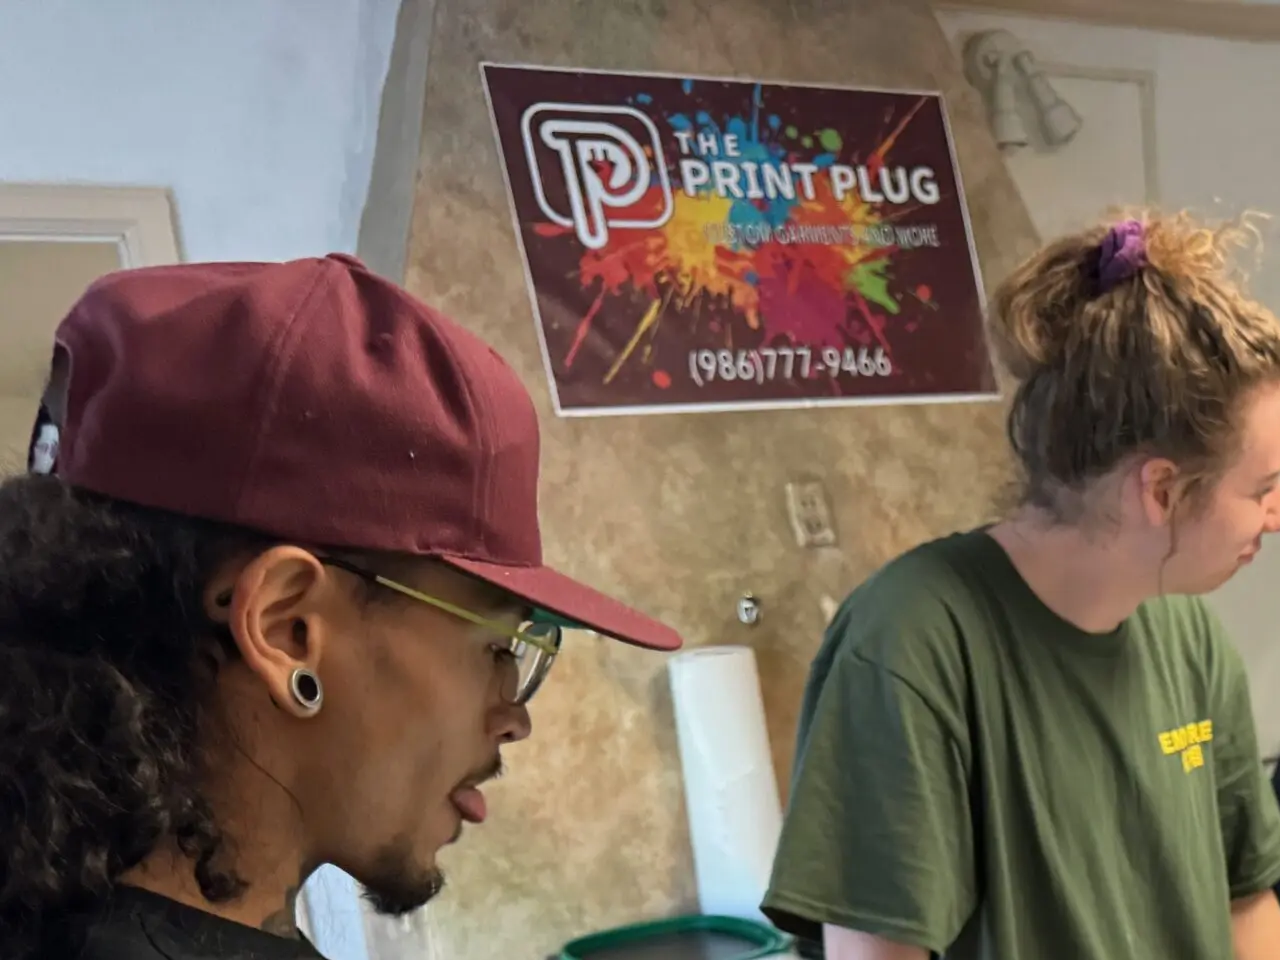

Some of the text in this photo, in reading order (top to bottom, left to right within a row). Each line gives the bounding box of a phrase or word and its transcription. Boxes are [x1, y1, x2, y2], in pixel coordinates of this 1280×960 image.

[673, 130, 742, 158] THE
[680, 158, 941, 205] PRINT PLUG
[688, 347, 893, 387] (986)777-9466
